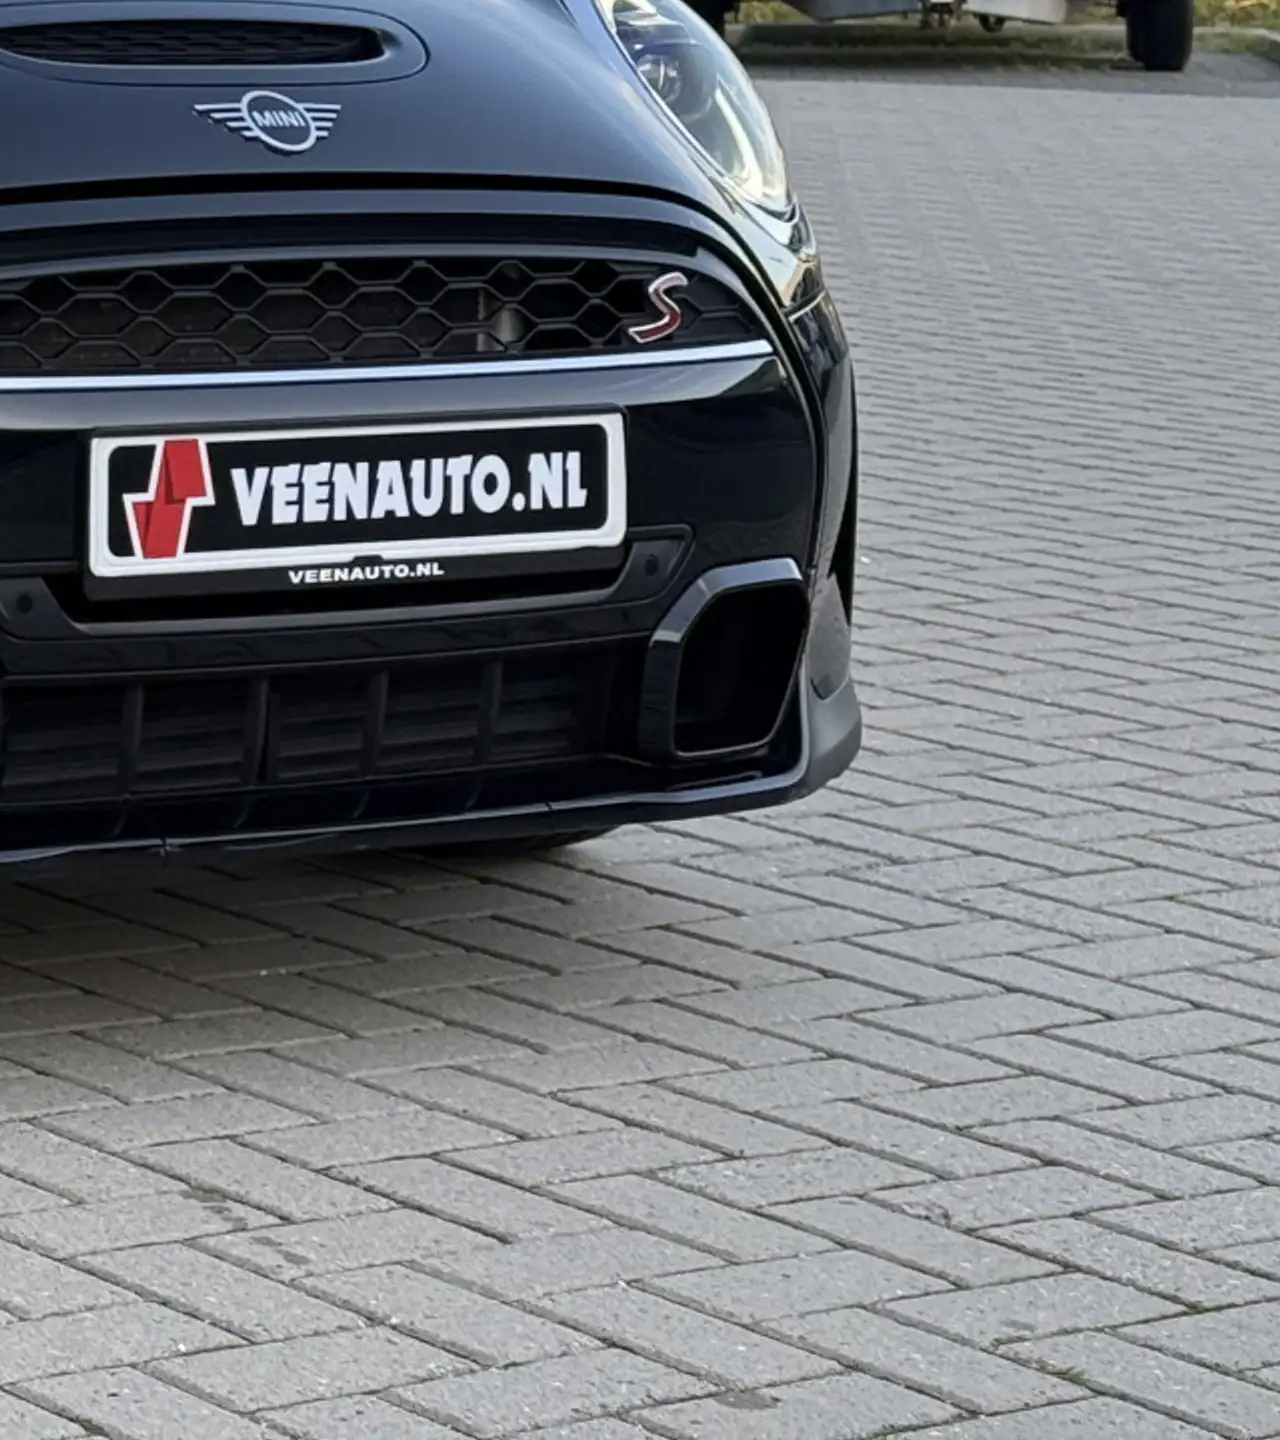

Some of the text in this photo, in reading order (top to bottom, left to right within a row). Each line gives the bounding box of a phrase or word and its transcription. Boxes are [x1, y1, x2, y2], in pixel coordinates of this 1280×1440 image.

[251, 110, 306, 127] MINI
[627, 272, 689, 344] S
[231, 451, 588, 527] VEENAUTO.NL
[288, 561, 445, 584] VEENAUTO.NL
